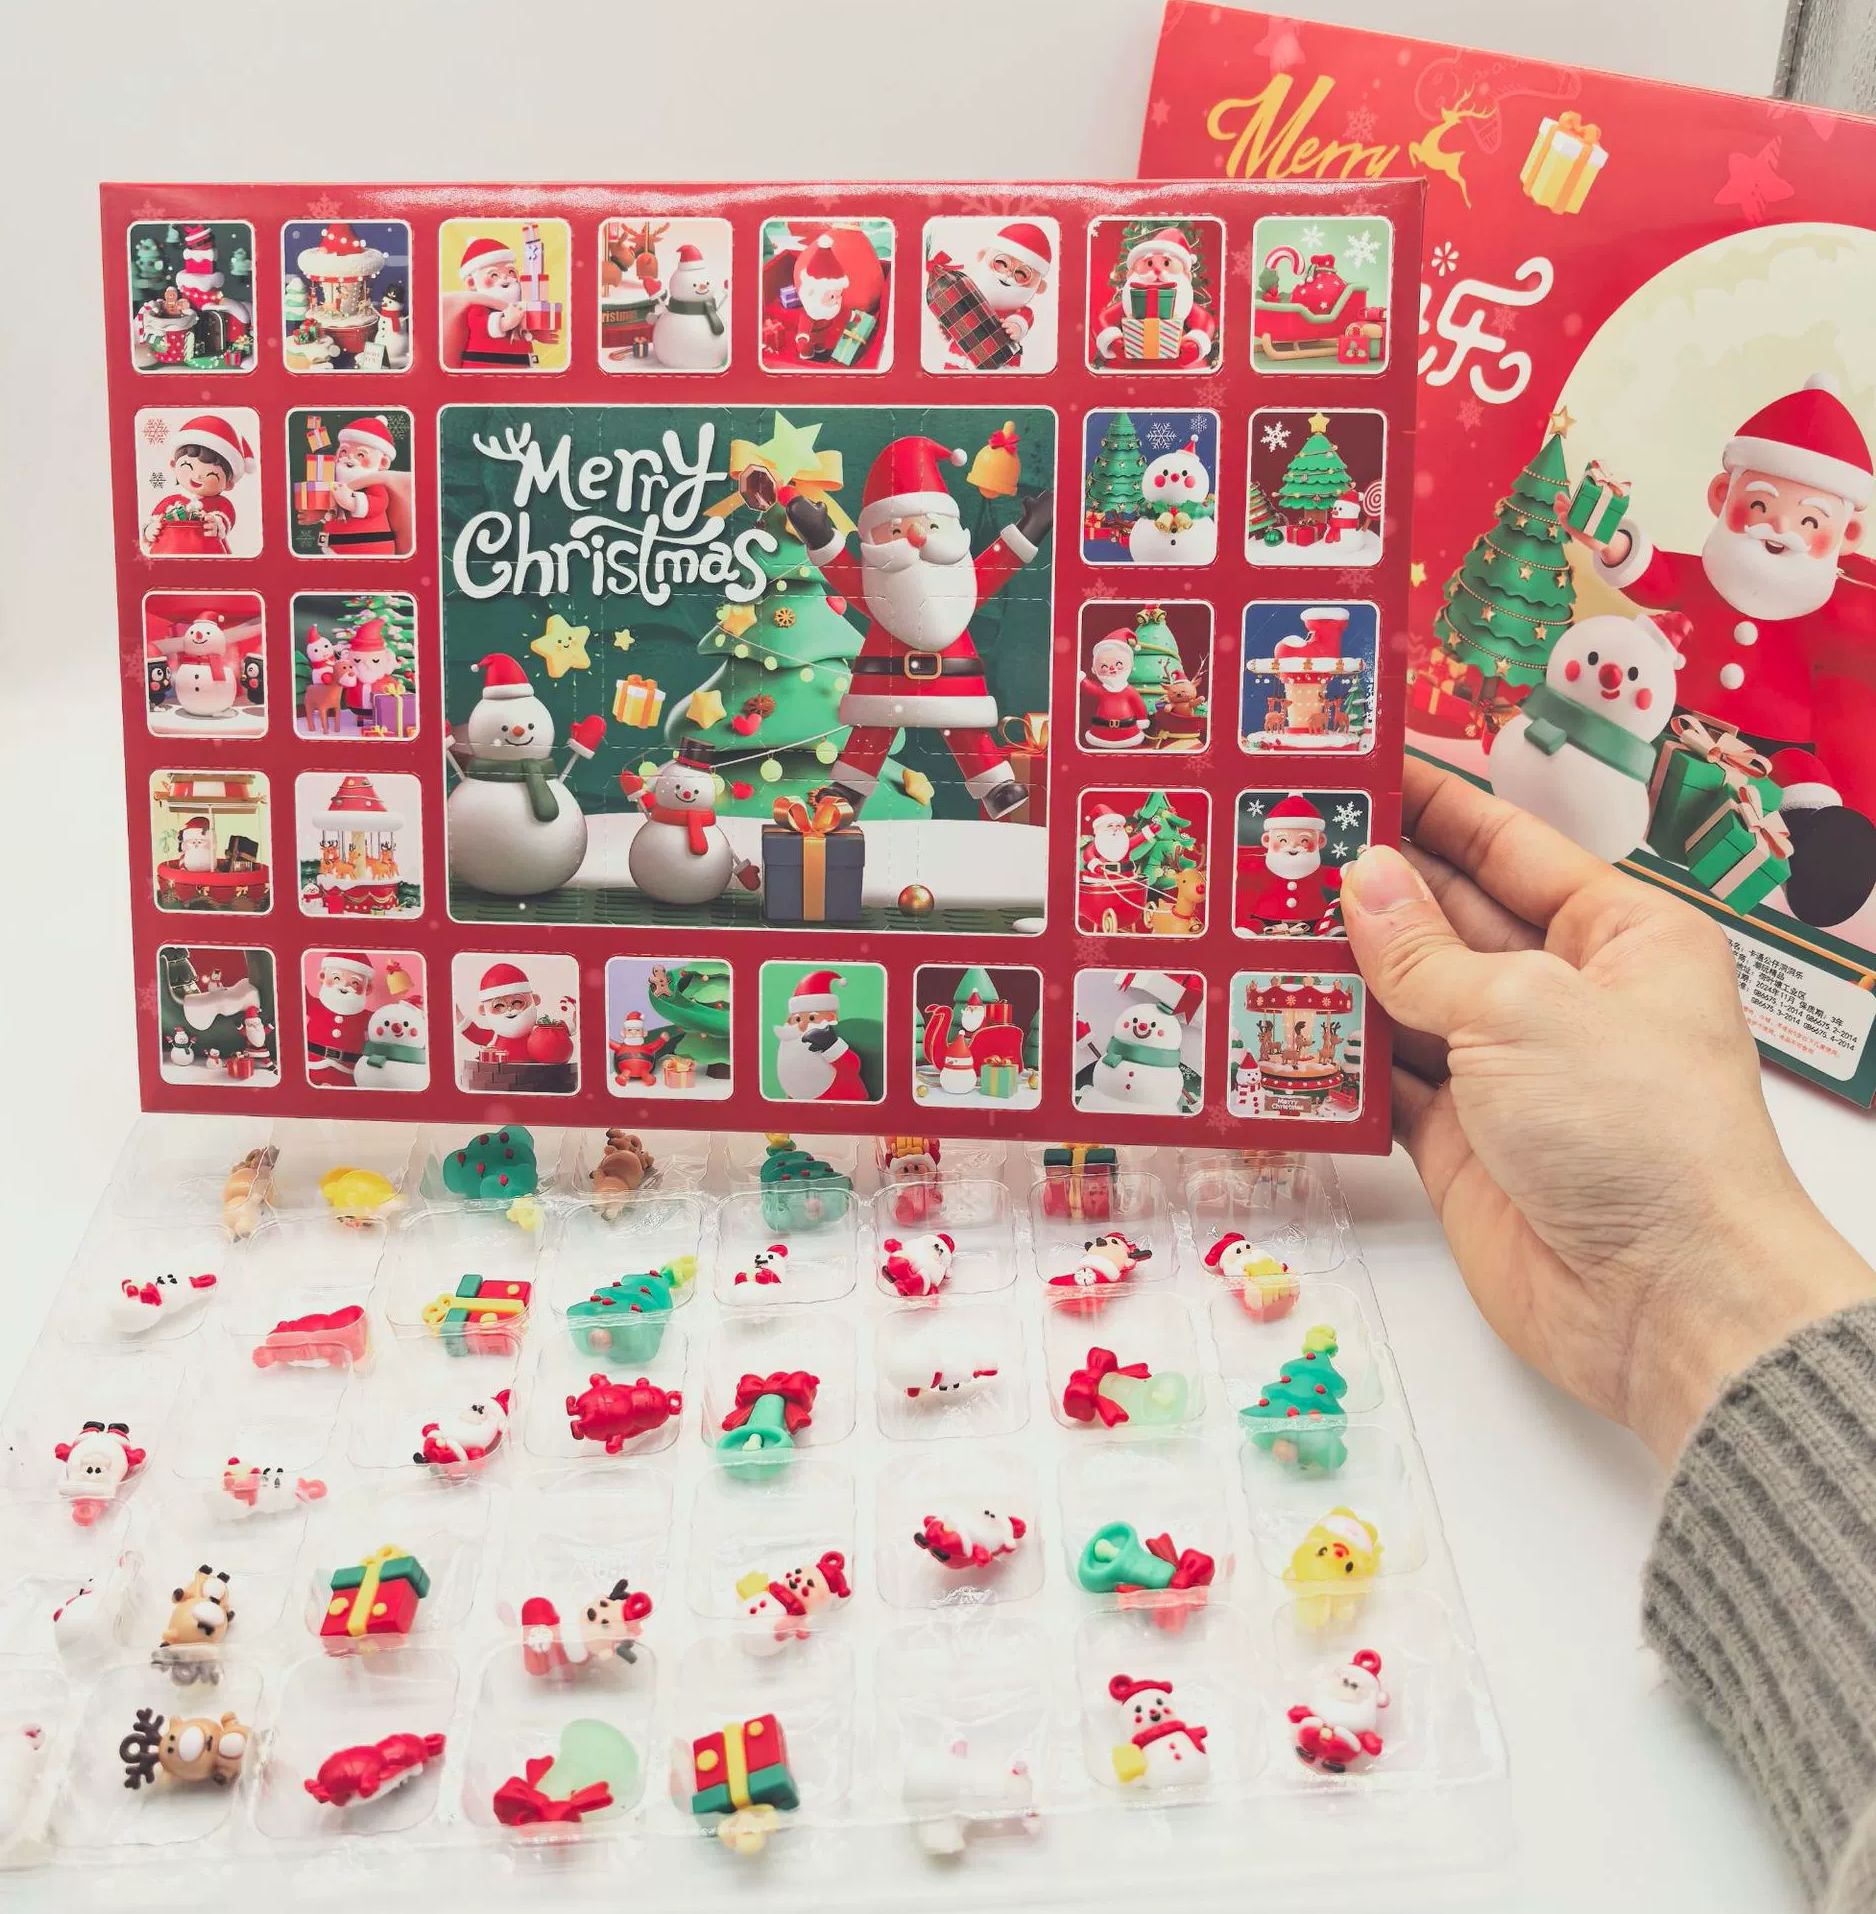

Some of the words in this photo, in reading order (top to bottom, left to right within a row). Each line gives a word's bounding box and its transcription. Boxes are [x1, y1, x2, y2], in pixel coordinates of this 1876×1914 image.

[1206, 72, 1400, 179] Merry
[473, 422, 728, 531] Merry
[453, 510, 778, 607] Christmas
